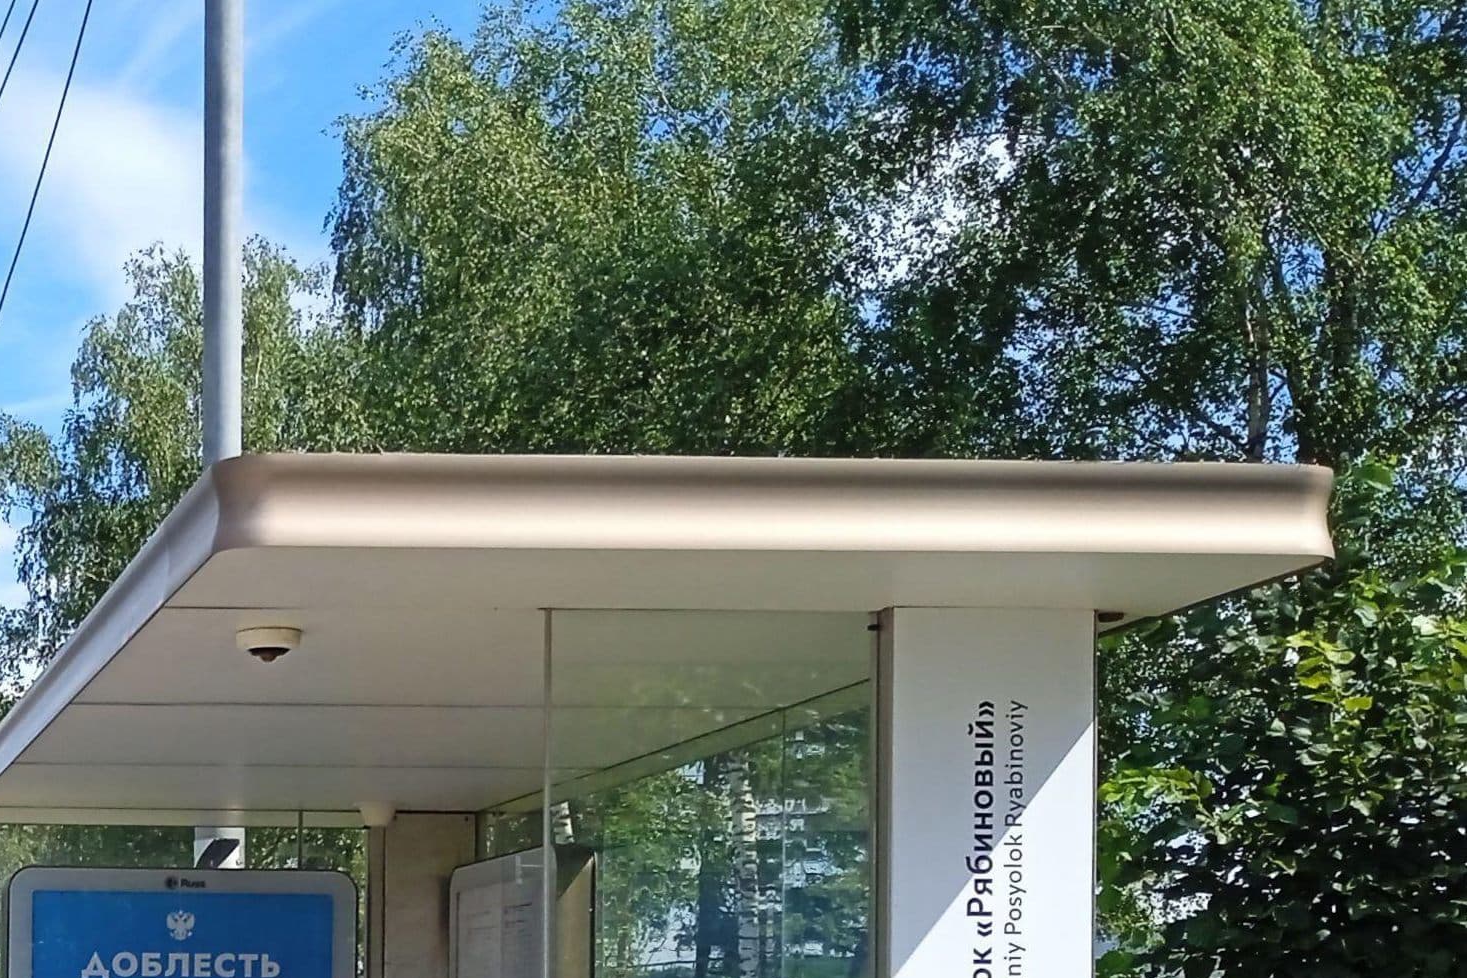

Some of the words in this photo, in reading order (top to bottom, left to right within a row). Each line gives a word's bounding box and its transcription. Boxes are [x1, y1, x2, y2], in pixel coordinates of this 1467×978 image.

[965, 701, 994, 937] «Рябиновый»
[1004, 700, 1028, 827] Ryabinoviy
[1004, 834, 1027, 935] Posyolok
